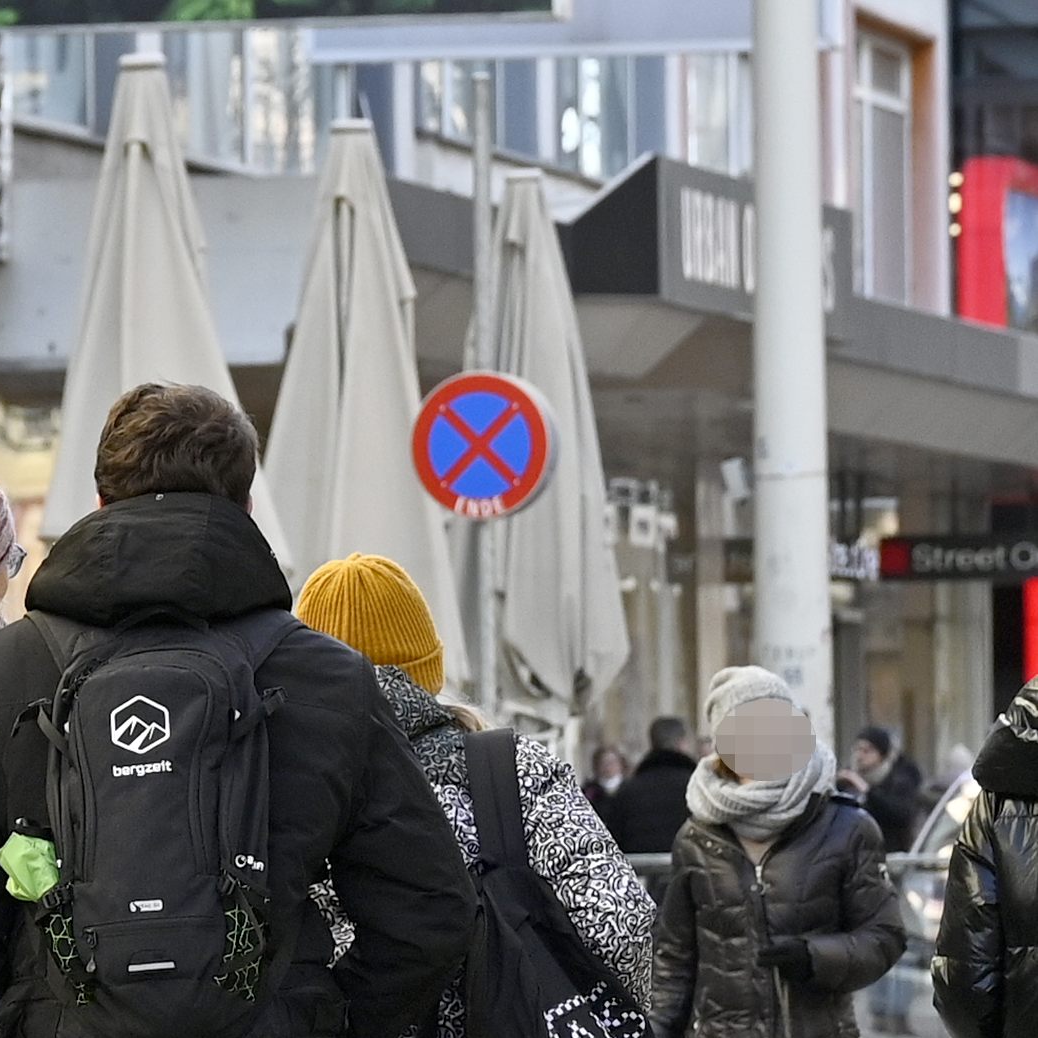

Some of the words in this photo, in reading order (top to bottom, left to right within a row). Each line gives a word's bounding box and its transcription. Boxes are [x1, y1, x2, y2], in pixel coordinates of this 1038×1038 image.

[681, 187, 739, 289] URBAN
[454, 495, 503, 517] ENDE
[913, 543, 1005, 573] Street
[112, 760, 172, 777] bergzeit
